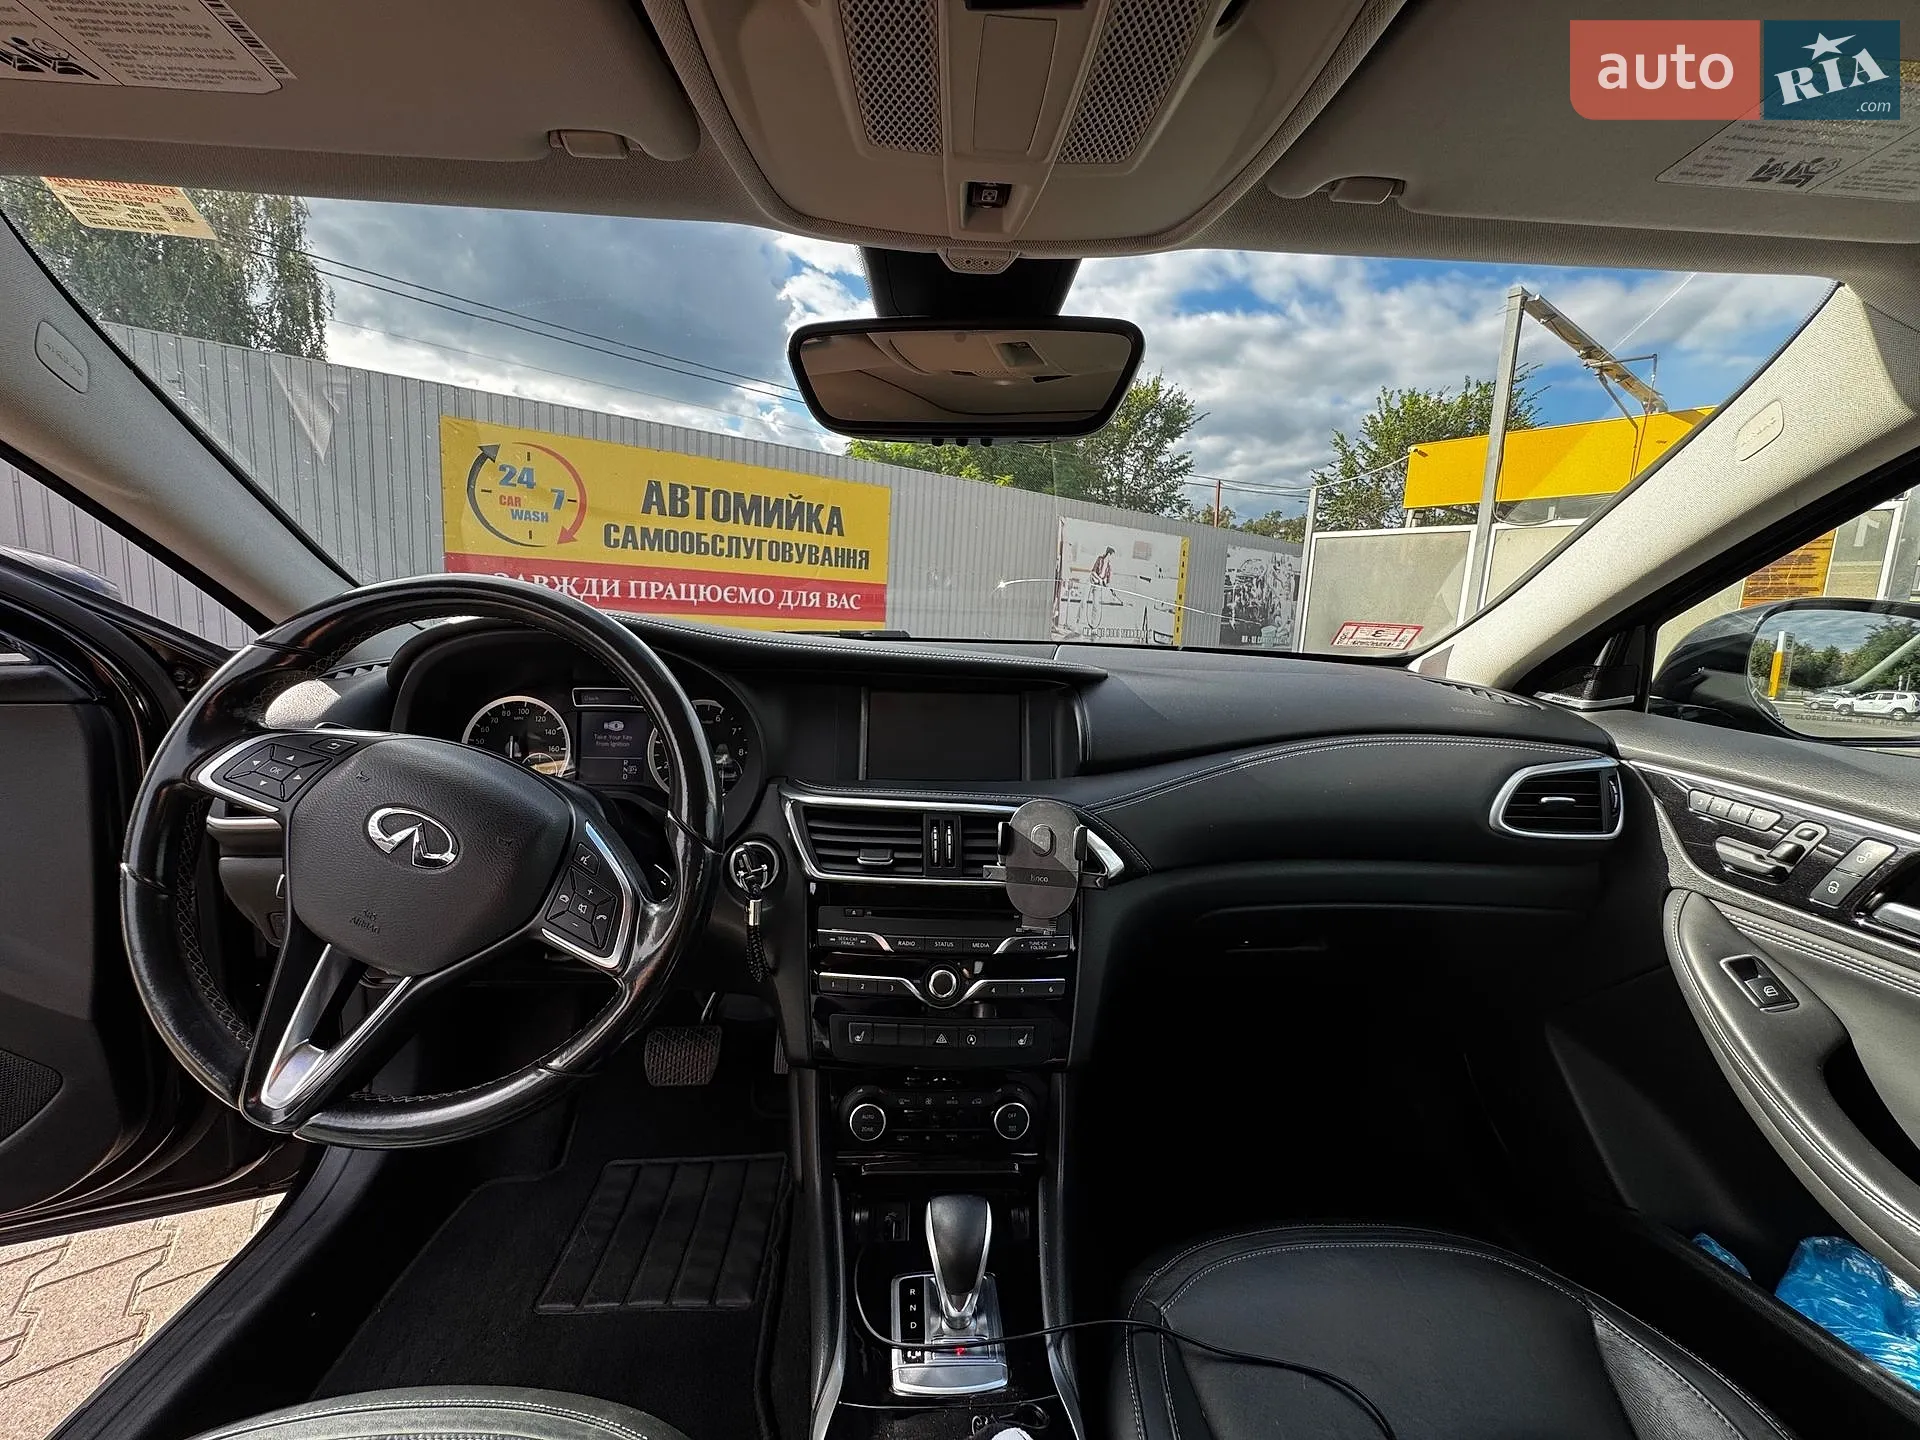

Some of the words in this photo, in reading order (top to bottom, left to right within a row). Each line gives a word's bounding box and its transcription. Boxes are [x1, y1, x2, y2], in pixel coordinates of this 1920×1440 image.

[128, 182, 177, 196] SERVICE
[498, 463, 537, 490] 24
[498, 495, 522, 508] CAR
[551, 488, 566, 511] 7
[641, 479, 845, 537] АВТОМИЙКА
[510, 509, 549, 523] WASH
[603, 523, 870, 571] САМООБСЛУГОВУВАННЯ
[495, 573, 621, 602] ВЖДИ
[628, 579, 774, 607] ПРАЦЮЄМО
[778, 587, 821, 610] ДЛЯ
[826, 590, 862, 611] ВАС
[909, 1288, 916, 1296] R
[909, 1304, 917, 1312] N
[910, 1321, 917, 1329] D
